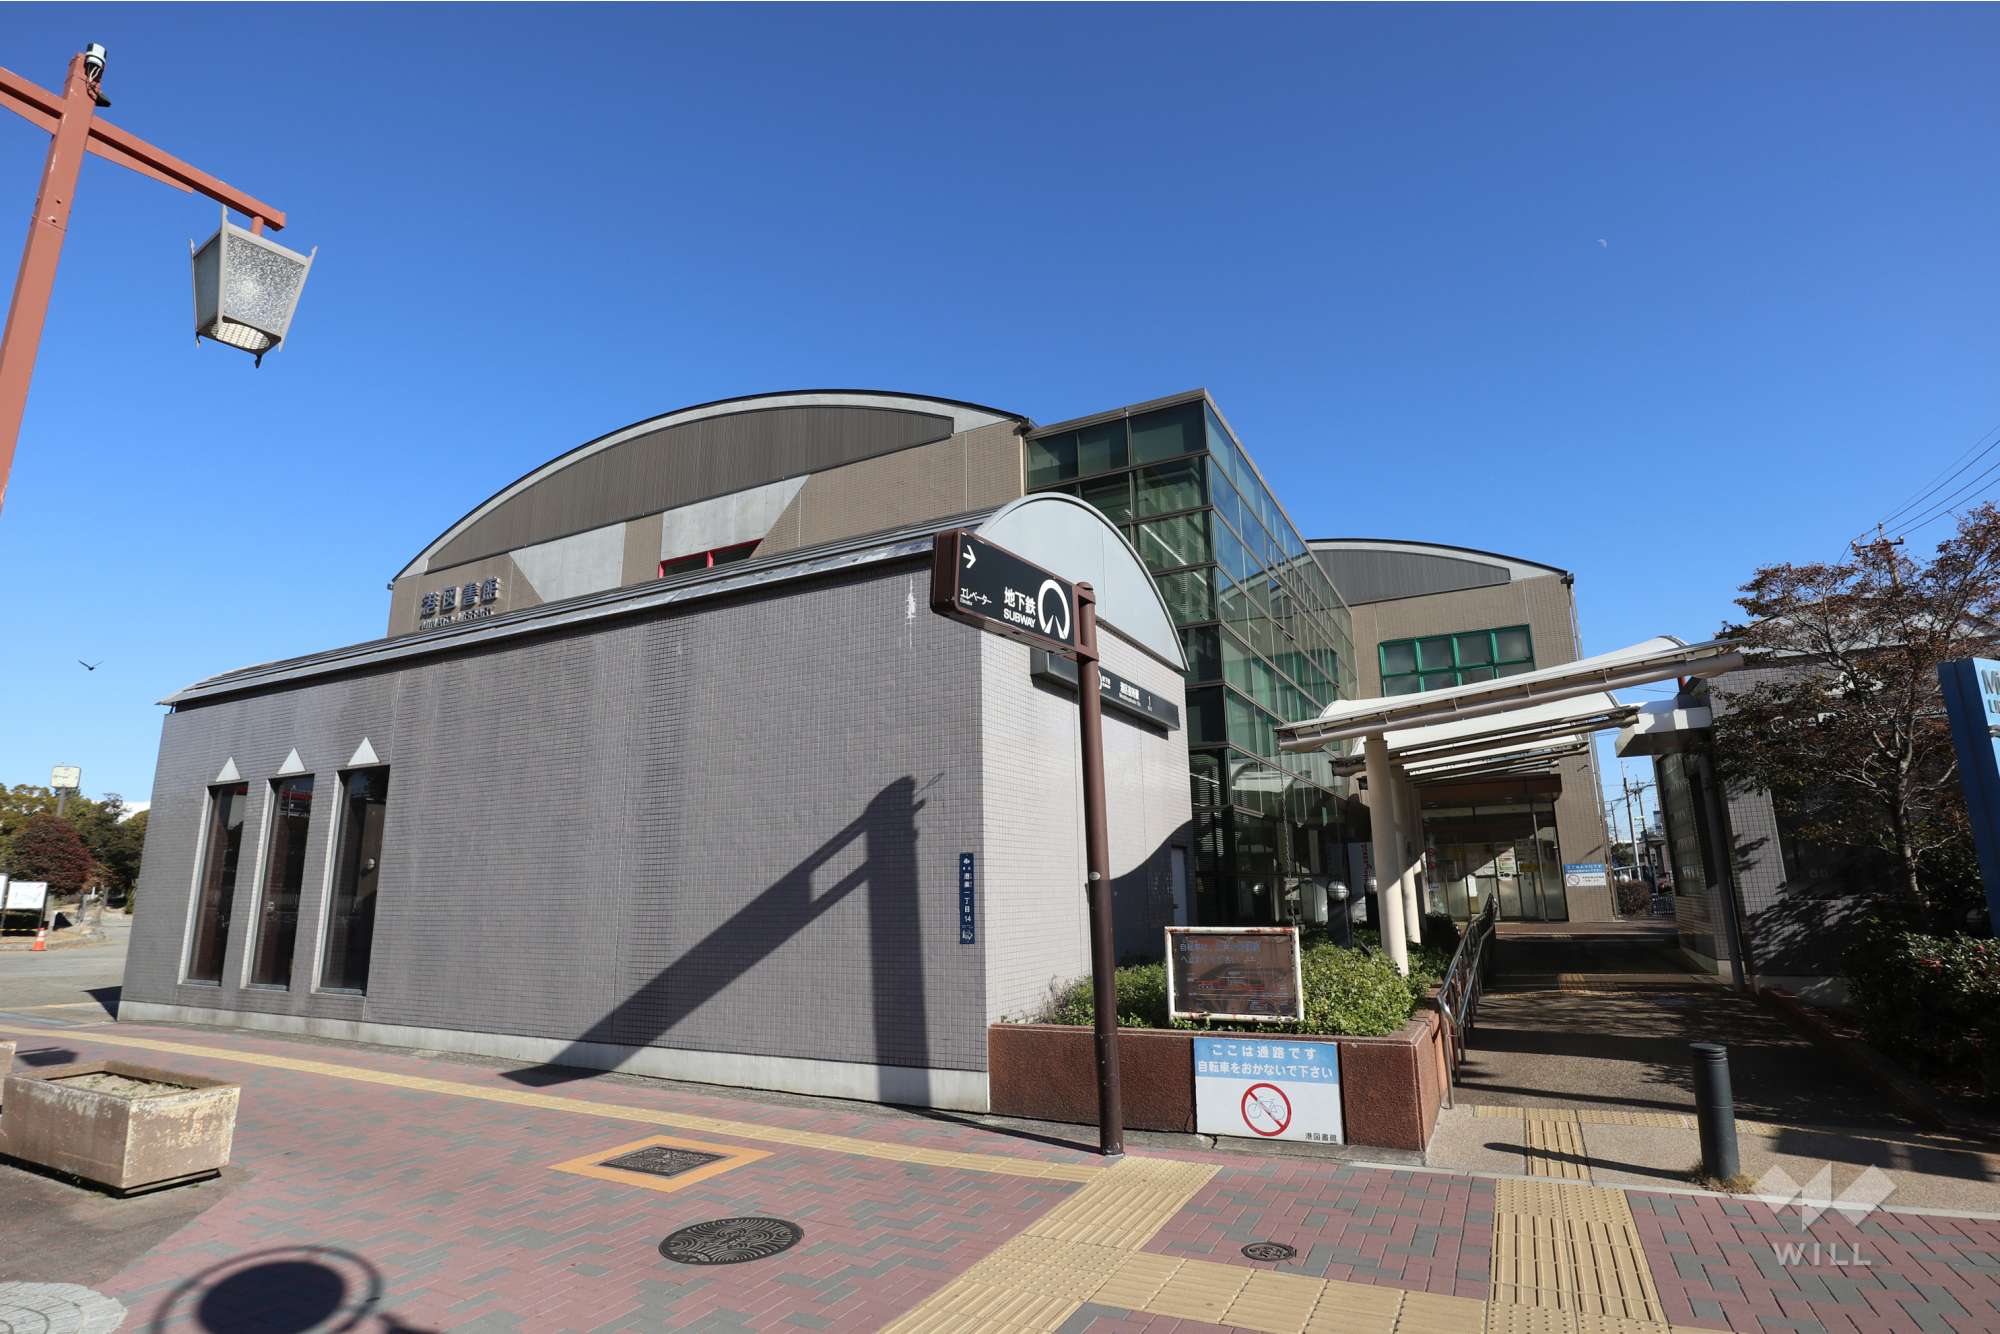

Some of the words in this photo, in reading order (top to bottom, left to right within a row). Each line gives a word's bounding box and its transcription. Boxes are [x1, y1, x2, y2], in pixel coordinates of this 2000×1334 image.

[960, 587, 992, 605] エレベーター
[1003, 586, 1036, 616] 地下鉄
[1003, 608, 1036, 628] SUBWAY
[1212, 1044, 1317, 1060] ここは通路です
[1198, 1060, 1333, 1079] 自転車をおかないで下さい
